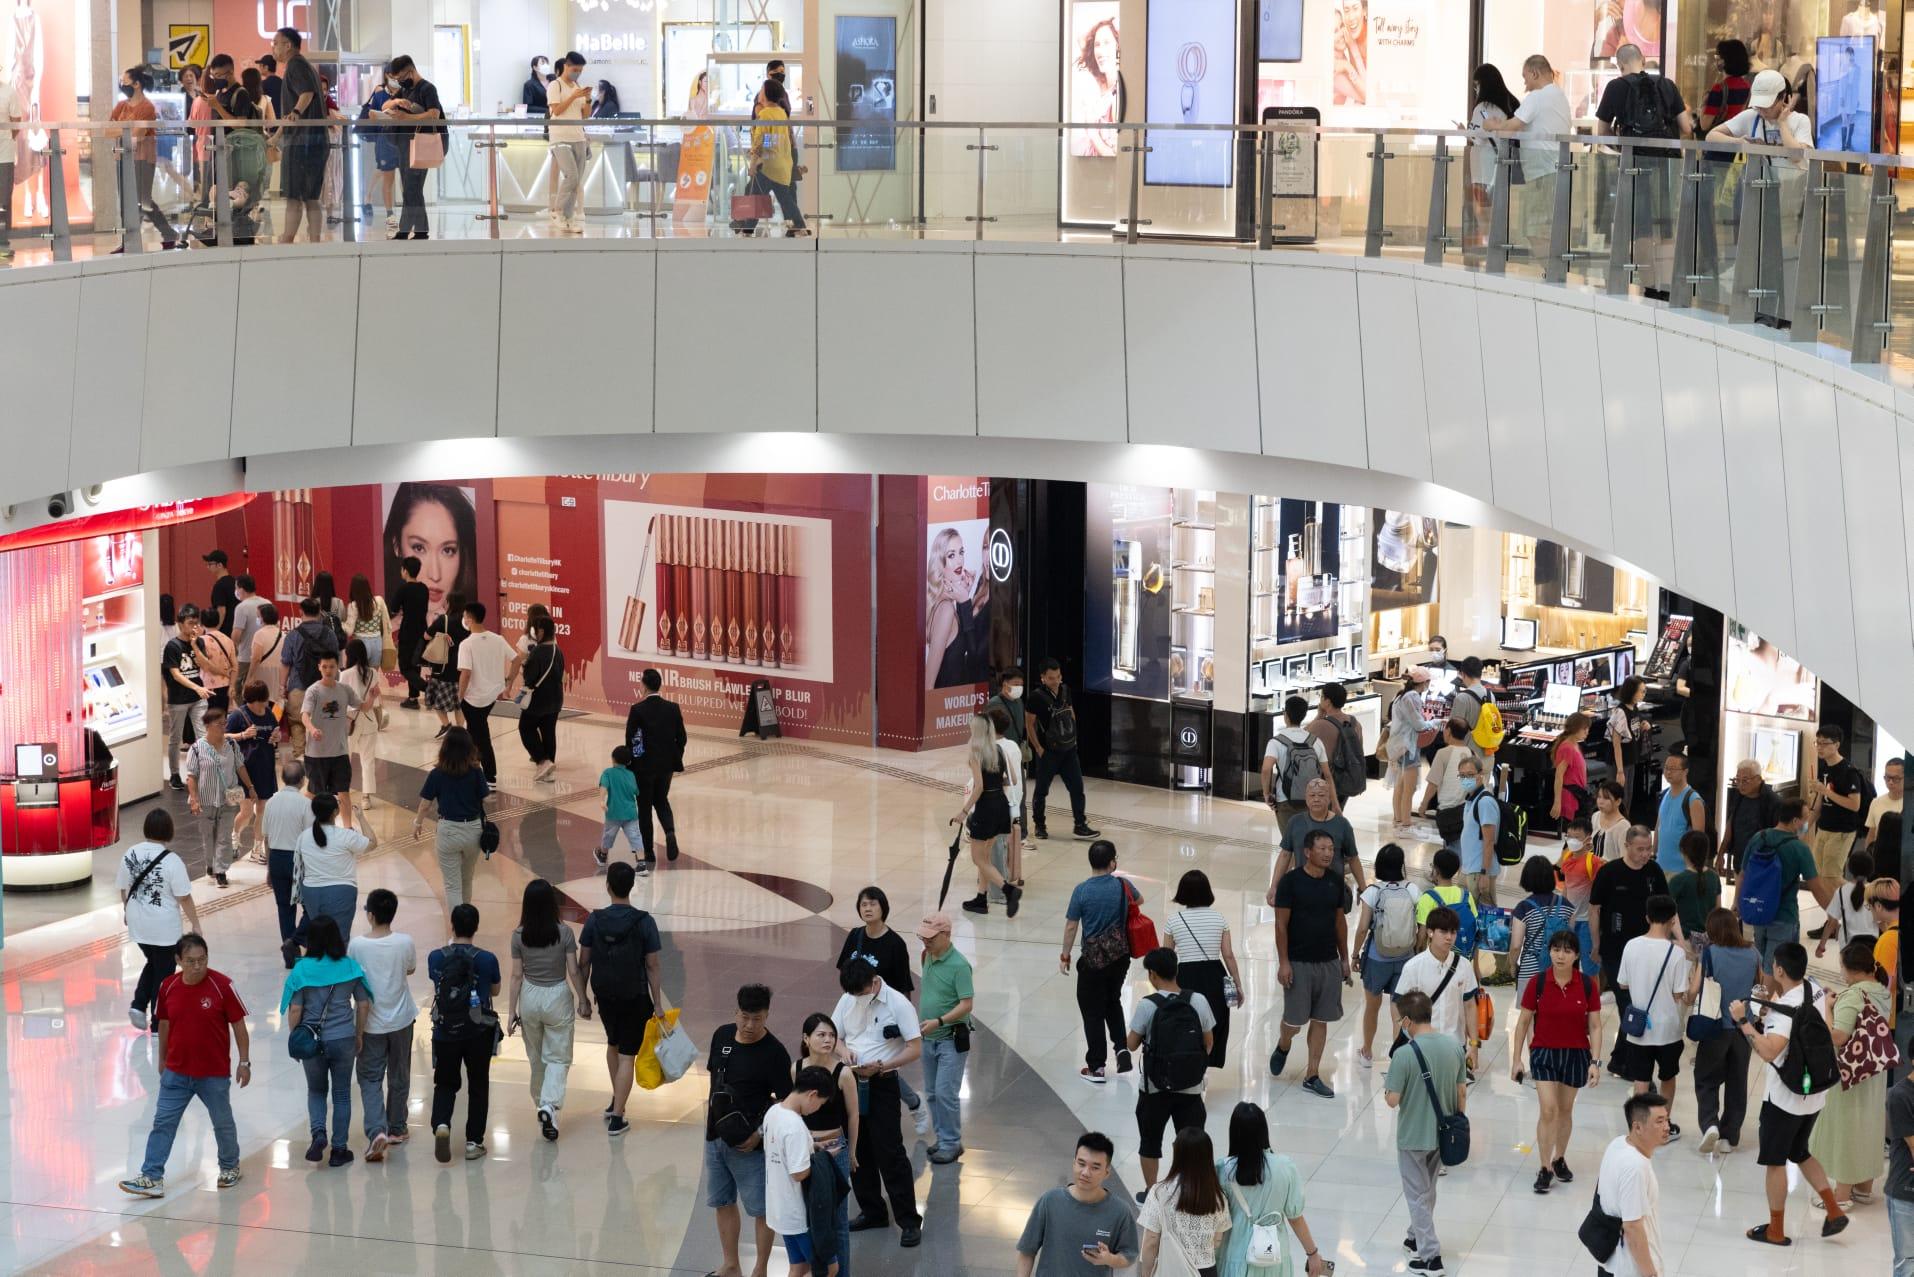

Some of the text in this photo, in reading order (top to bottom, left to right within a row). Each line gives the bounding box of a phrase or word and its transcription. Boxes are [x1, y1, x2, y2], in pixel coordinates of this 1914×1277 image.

[575, 33, 646, 51] MaBelle
[552, 606, 562, 619] IN
[628, 671, 643, 683] NE
[714, 680, 751, 696] FLAWLE
[785, 689, 811, 704] BLUR
[943, 692, 985, 711] WORLD'S
